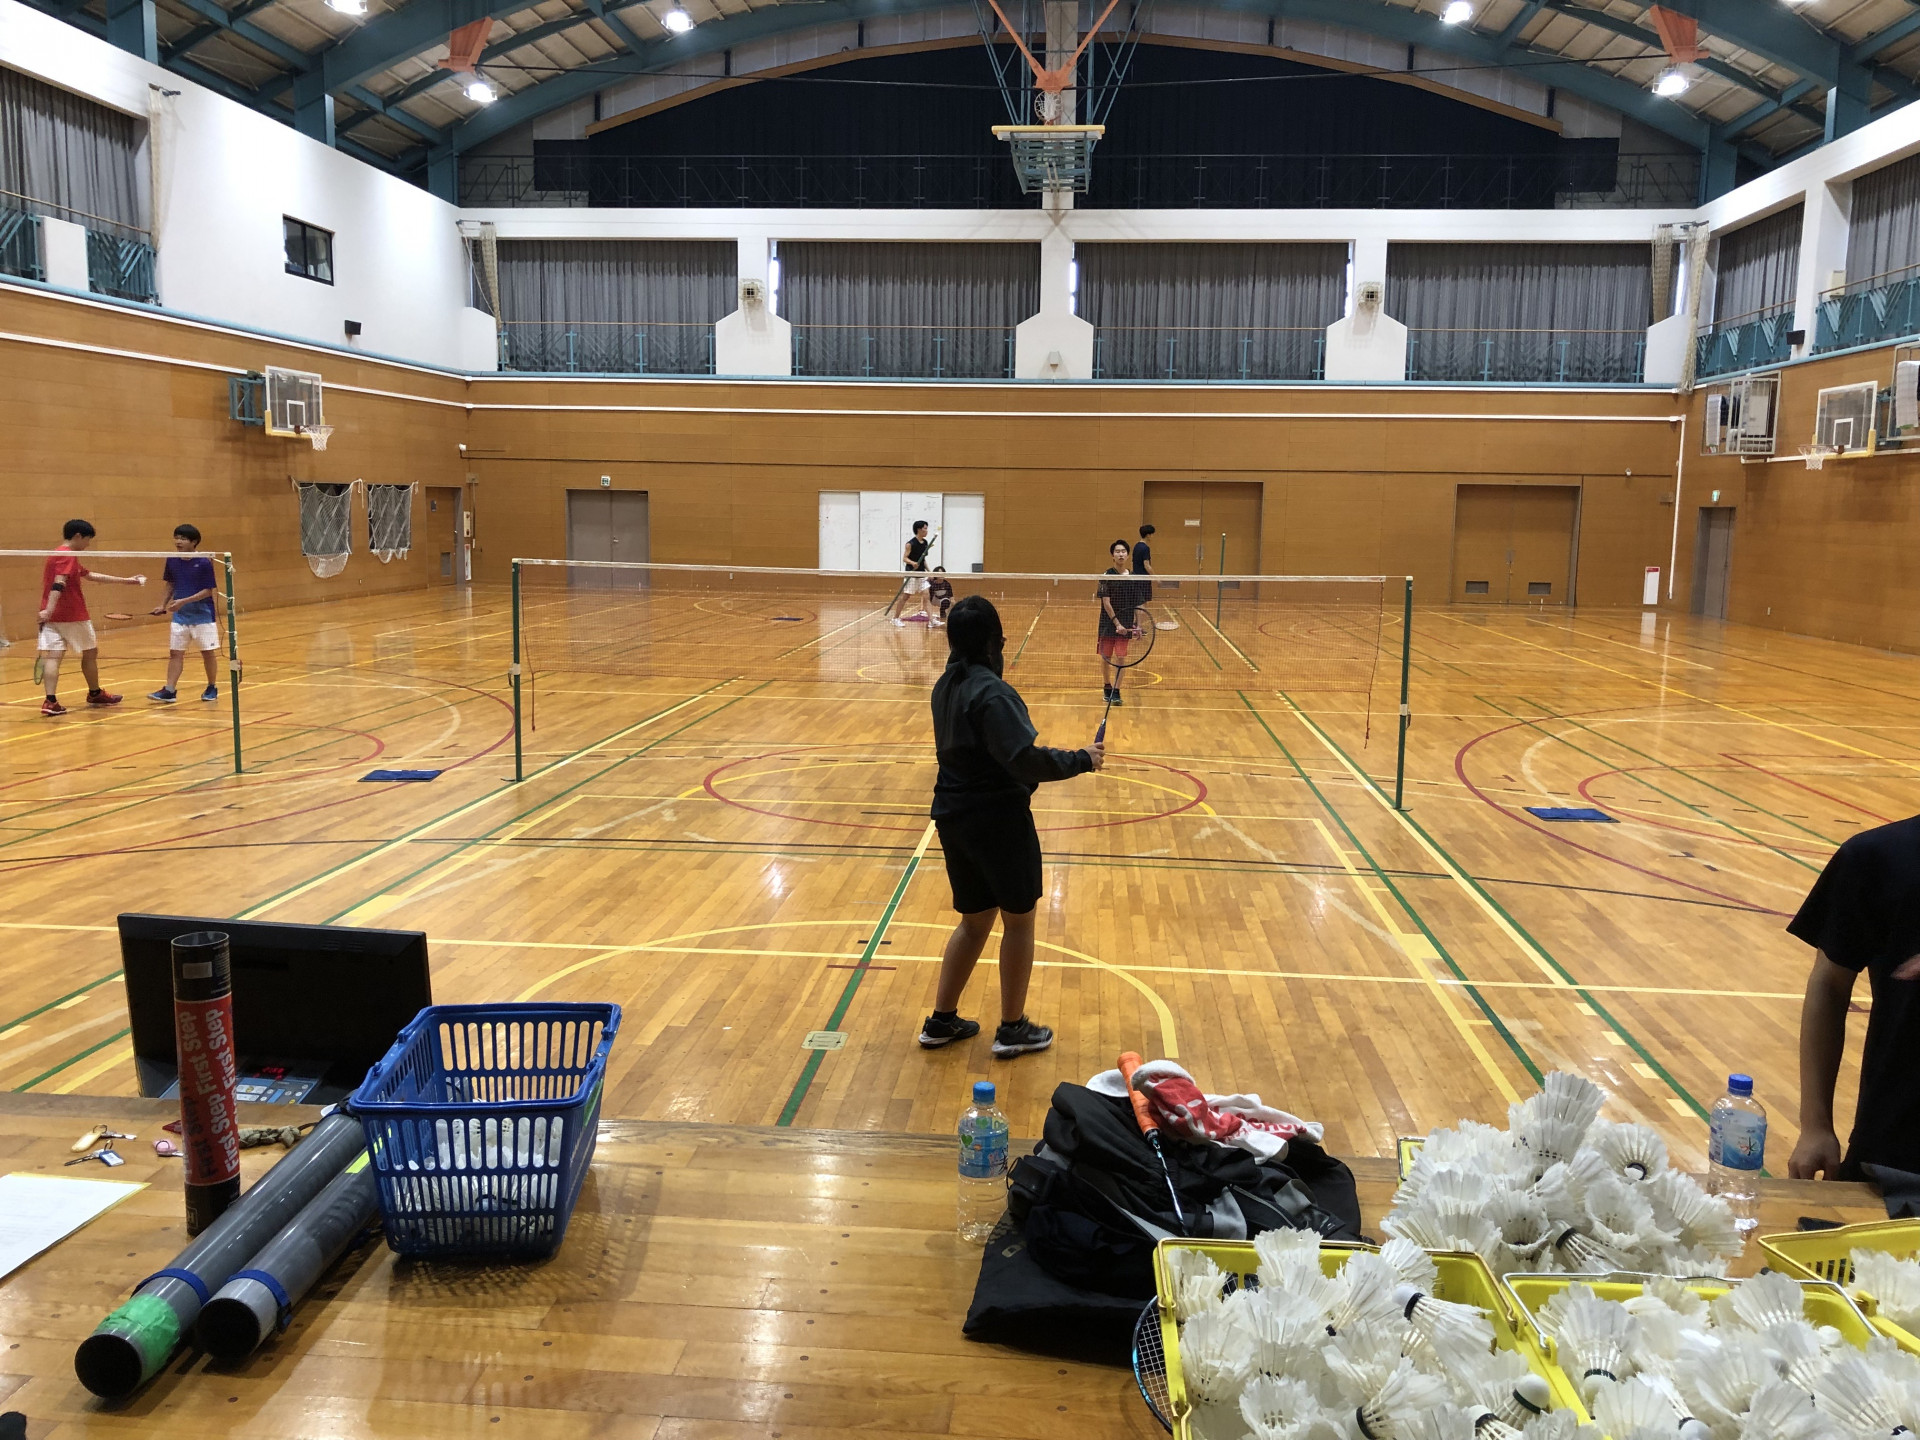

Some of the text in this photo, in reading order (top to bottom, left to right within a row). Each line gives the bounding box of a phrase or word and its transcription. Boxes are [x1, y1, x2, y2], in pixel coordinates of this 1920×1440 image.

[206, 1009, 227, 1050] Step
[216, 1047, 236, 1090] First
[180, 1012, 239, 1173] First Step First Step
